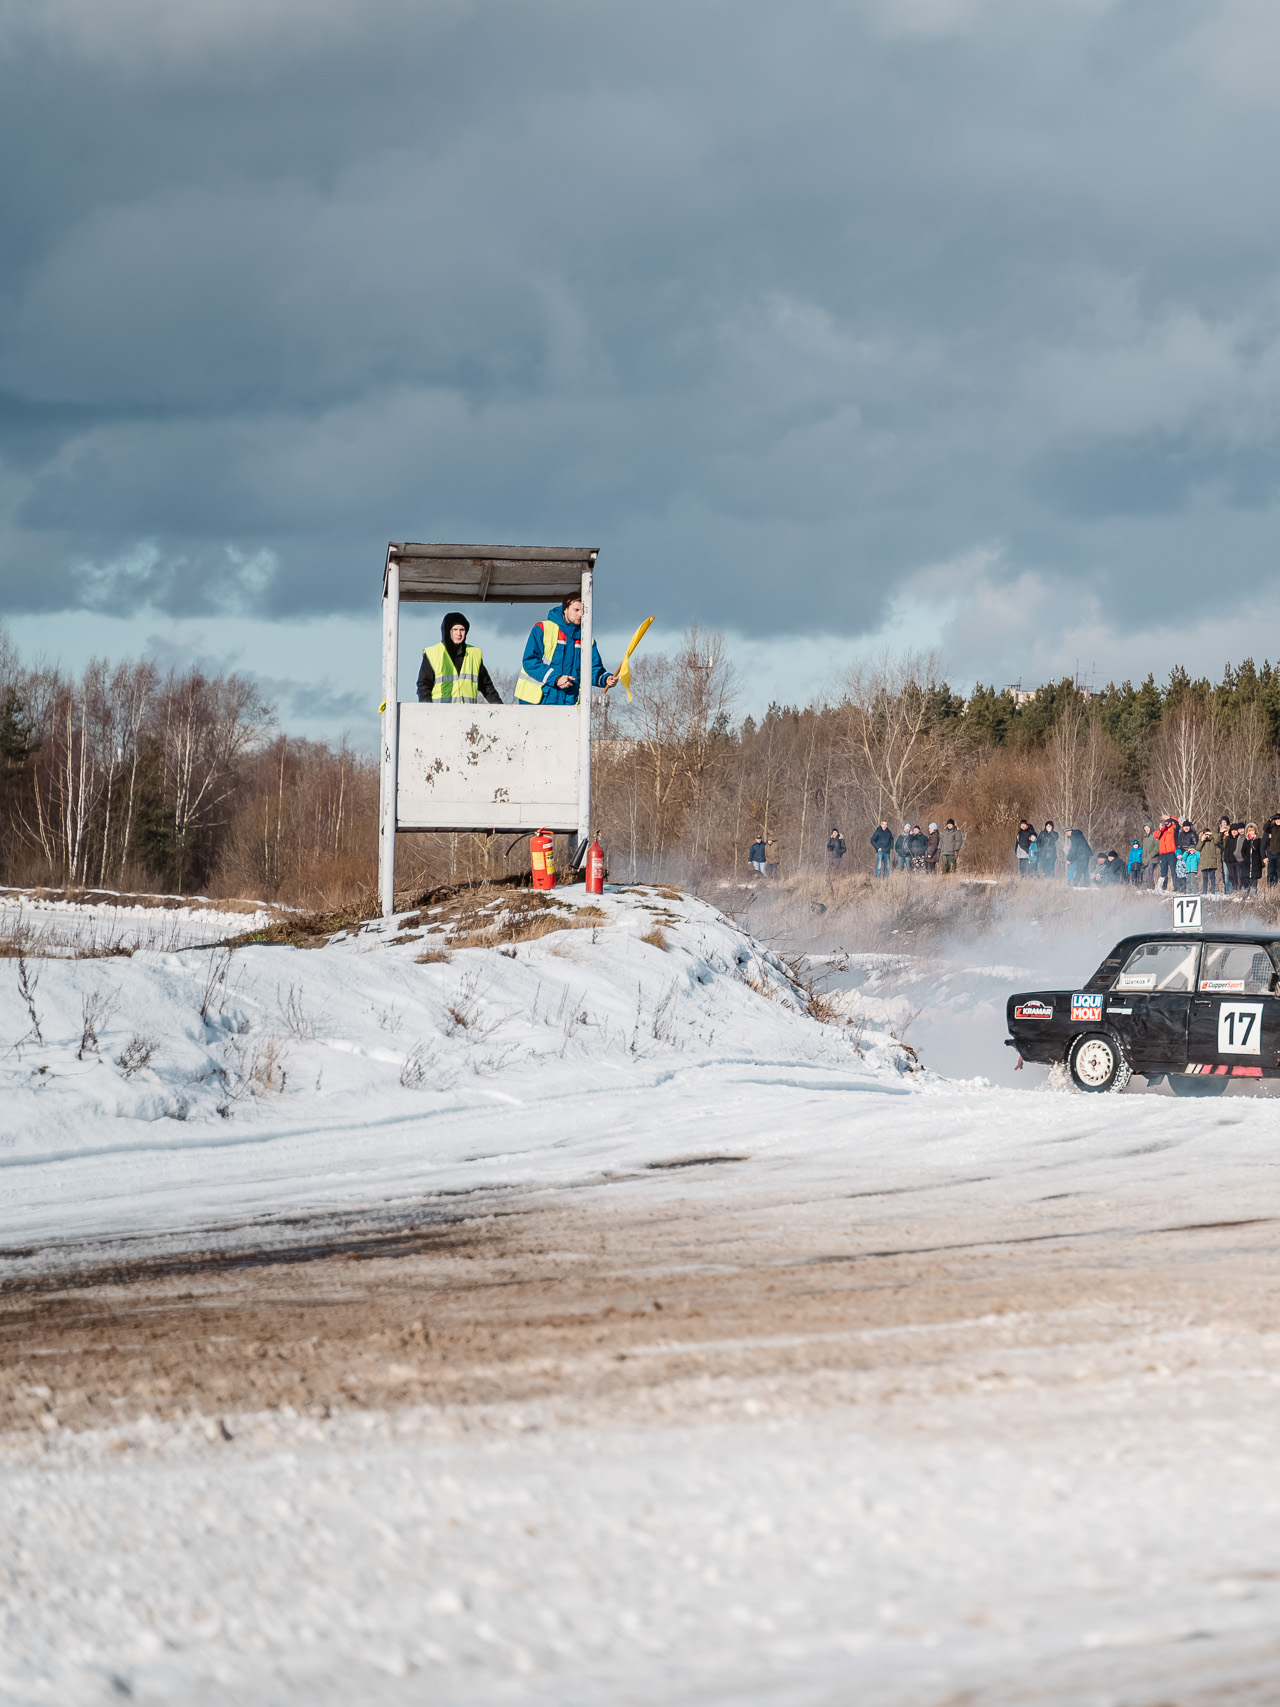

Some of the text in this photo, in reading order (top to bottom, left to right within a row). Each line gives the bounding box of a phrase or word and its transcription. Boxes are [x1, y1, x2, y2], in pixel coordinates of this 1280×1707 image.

[1176, 900, 1198, 923] 17
[1073, 996, 1102, 1007] LIQUI
[1072, 1008, 1101, 1019] MOLY
[1224, 1012, 1257, 1046] 17
